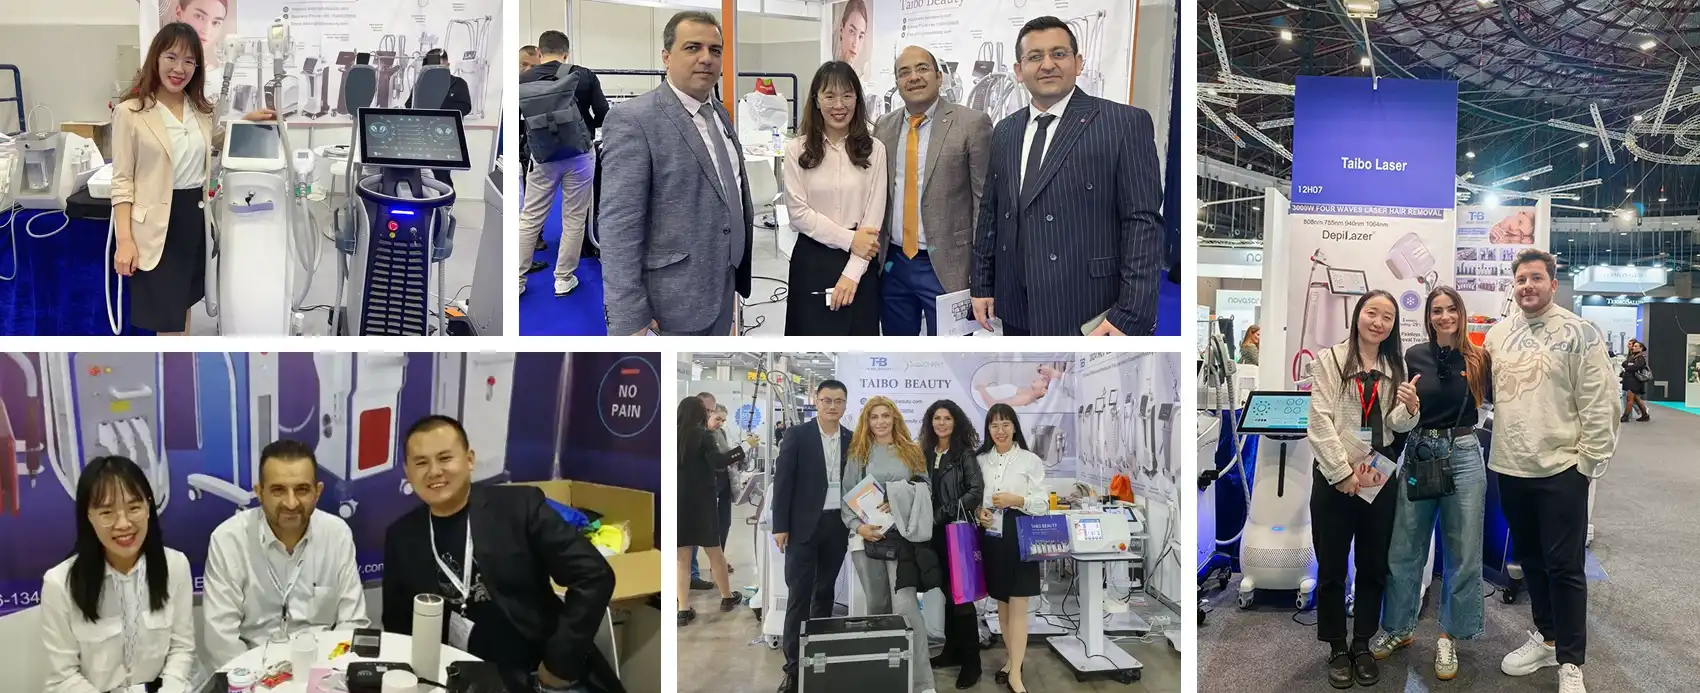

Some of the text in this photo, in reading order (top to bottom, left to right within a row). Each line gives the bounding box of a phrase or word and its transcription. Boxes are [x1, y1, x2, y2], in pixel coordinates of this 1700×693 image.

[1341, 157, 1407, 171] Taibo Laser
[1298, 185, 1323, 194] 12H07
[619, 384, 637, 398] NO
[860, 379, 951, 389] TAIBO BEAUTY
[612, 403, 641, 418] PAIN
